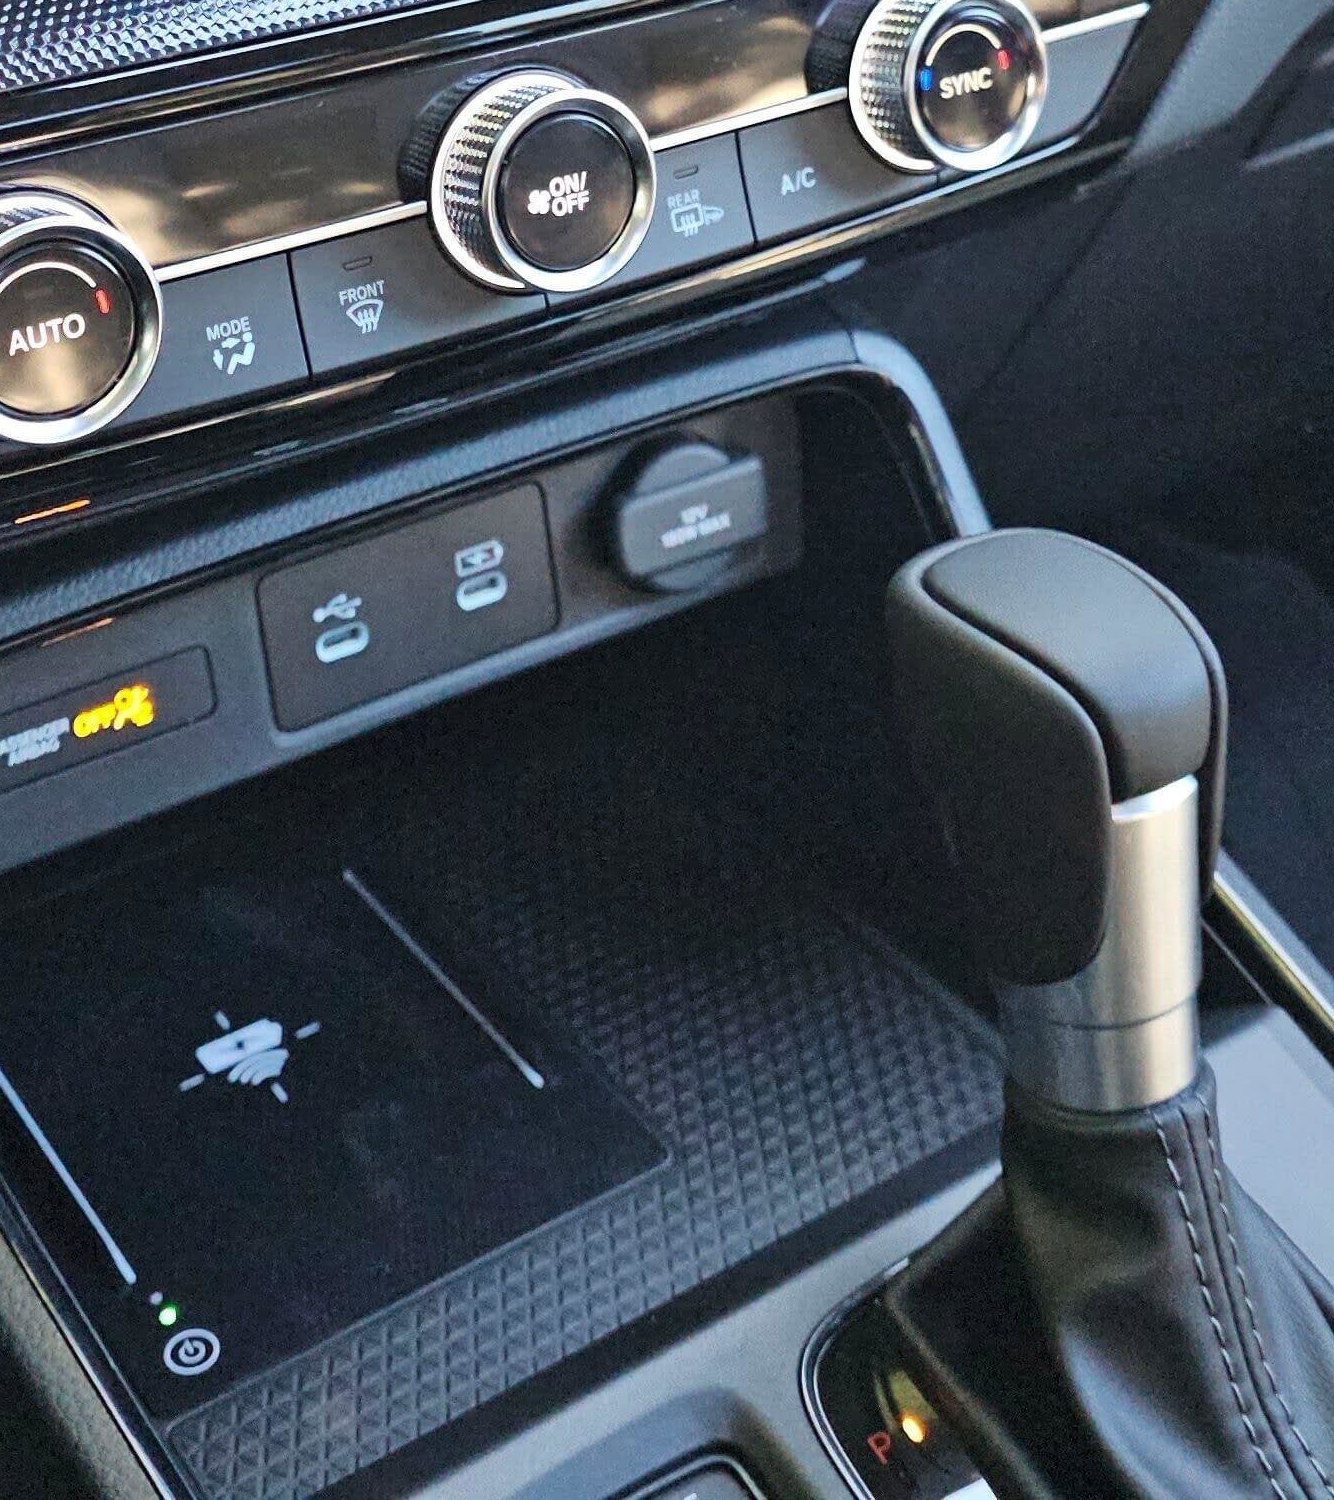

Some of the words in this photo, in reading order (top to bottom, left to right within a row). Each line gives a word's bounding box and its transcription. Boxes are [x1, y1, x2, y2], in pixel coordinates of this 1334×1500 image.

[939, 67, 993, 99] SYNC
[549, 170, 587, 198] ON/
[781, 166, 816, 196] A/C
[551, 190, 590, 217] OFF
[667, 188, 701, 210] REAR
[338, 279, 385, 306] FRONT
[8, 312, 86, 357] AUTO
[206, 315, 252, 343] MODE
[867, 1431, 891, 1465] P
